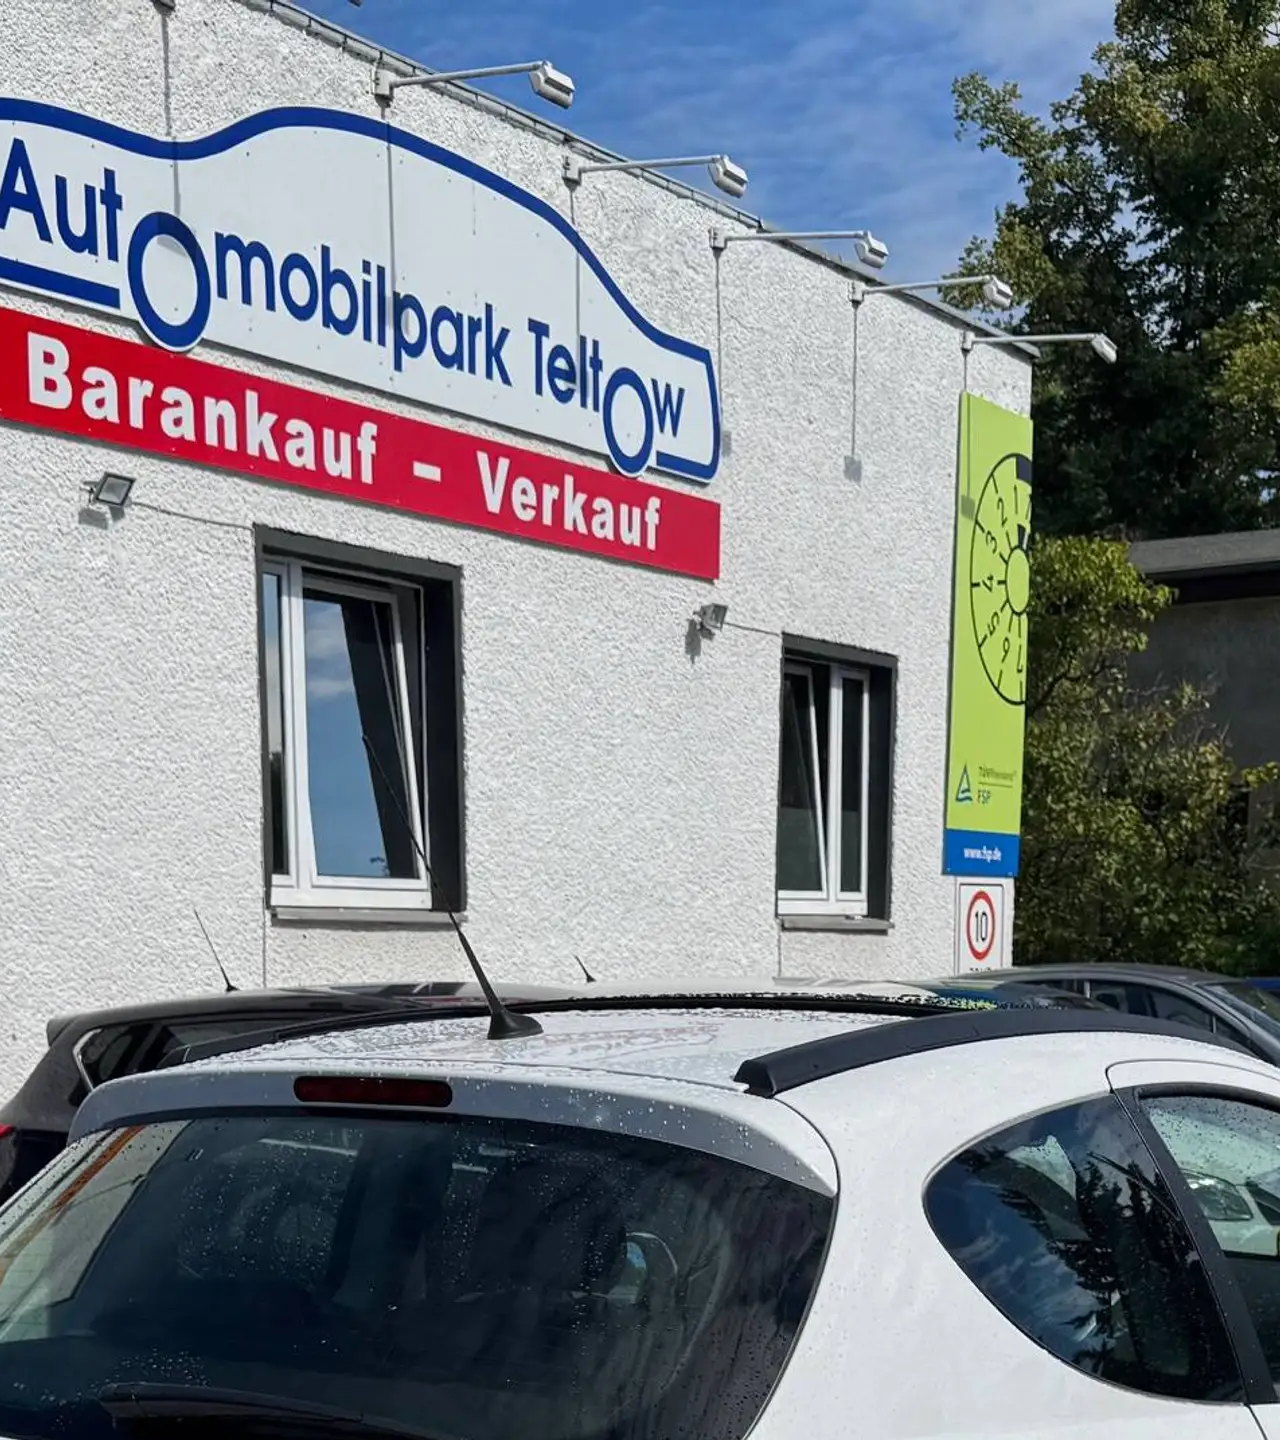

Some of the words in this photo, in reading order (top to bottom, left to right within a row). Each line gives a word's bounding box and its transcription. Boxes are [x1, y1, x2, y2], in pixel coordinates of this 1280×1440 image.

[28, 332, 377, 484] Barankauf
[478, 452, 661, 550] Verkauf
[528, 321, 684, 474] Teltow
[975, 911, 988, 943] 10
